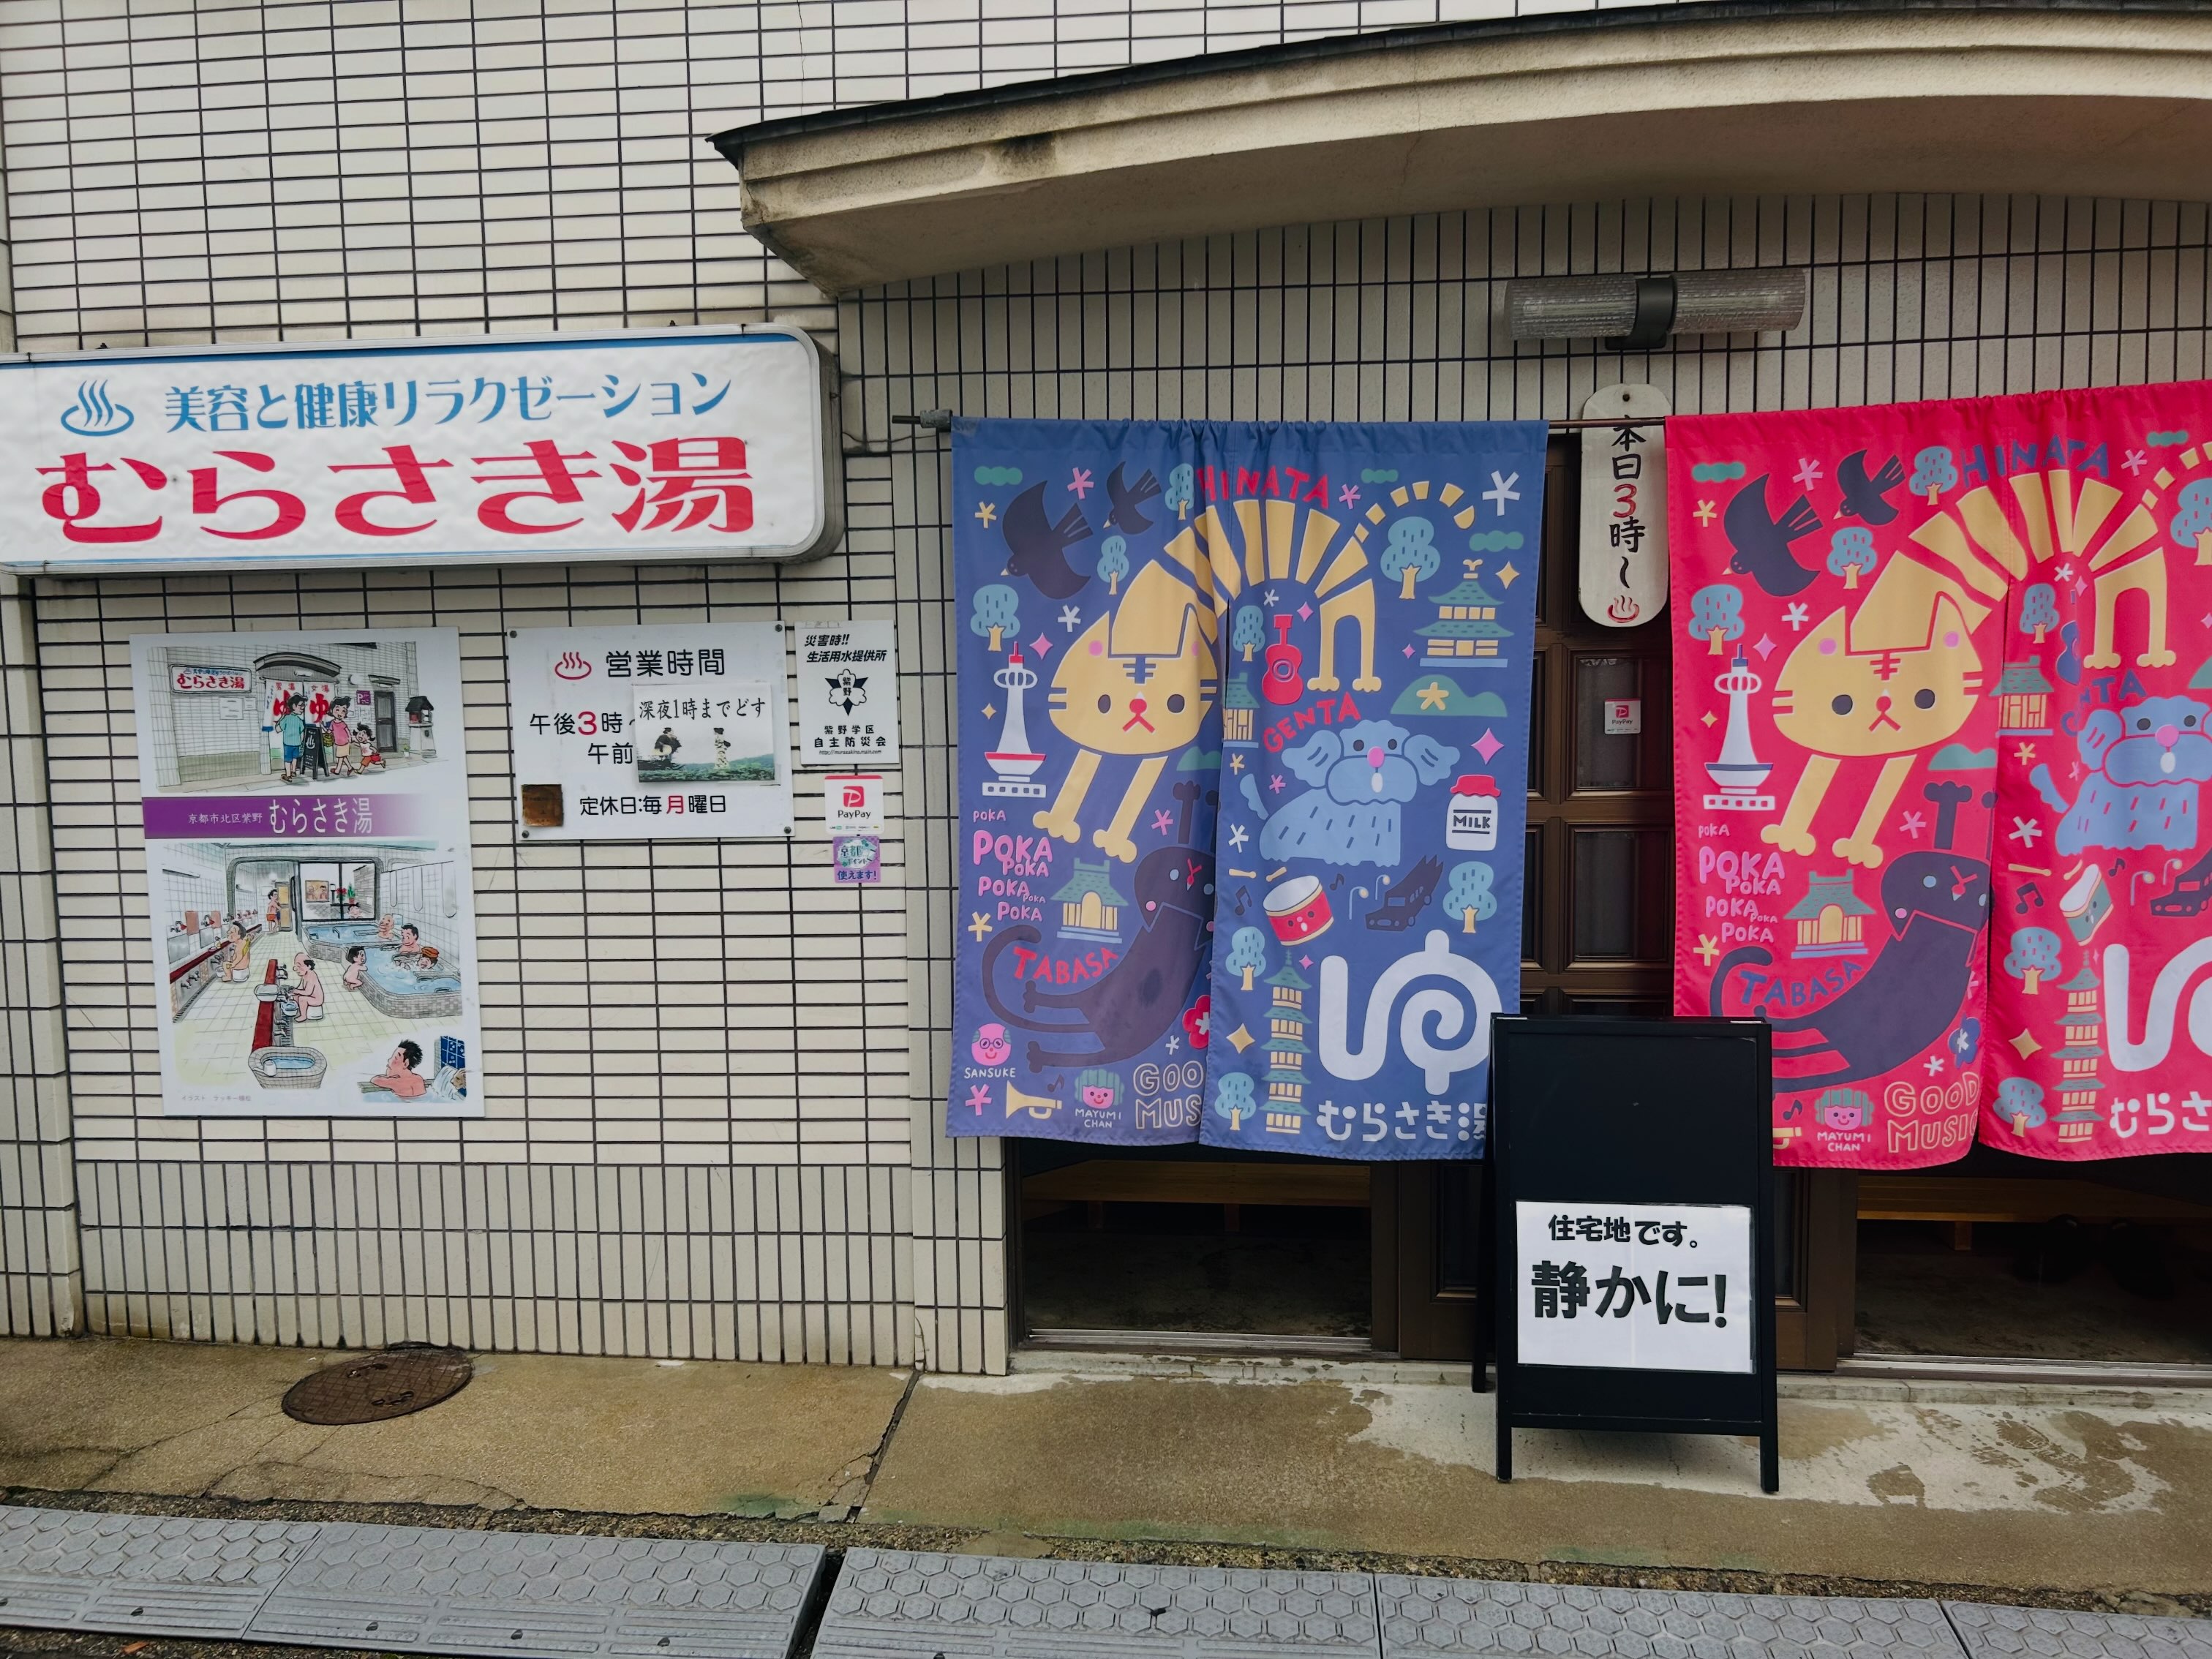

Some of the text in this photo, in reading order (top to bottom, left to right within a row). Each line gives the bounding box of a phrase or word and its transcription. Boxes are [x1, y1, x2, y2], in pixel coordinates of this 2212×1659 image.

[165, 371, 731, 433] 美容と健康リラクゼーション
[1960, 434, 2109, 489] HINATA
[35, 437, 754, 543] むらさき湯
[1196, 464, 1329, 509] HINATA
[606, 649, 725, 678] 営業時間
[806, 650, 887, 663] 生活用水提供所
[177, 673, 245, 689] むらさき湯
[639, 697, 766, 721] 深夜1時までどす
[824, 725, 875, 734] 紫野学区
[1263, 692, 1361, 753] GENTA
[587, 742, 633, 764] 午前
[814, 736, 887, 748] 自主防災会
[187, 797, 372, 834] 京都市北区紫野 むらさき湯
[838, 810, 871, 819] PayPay
[1453, 815, 1491, 830] MILK
[838, 870, 876, 880] 使えます!
[1012, 947, 1118, 985] TABASA
[1739, 960, 1862, 1007] TABASA
[964, 1067, 1016, 1078] SANSUKE
[1884, 1072, 1980, 1118] GOOD
[1075, 1108, 1121, 1120] MAYUMI
[1084, 1118, 1113, 1129] CHAN
[1817, 1132, 1871, 1143] MAYUMI
[1828, 1142, 1861, 1152] CHAN
[1548, 1214, 1698, 1248] 住宅地です。
[1531, 1260, 1727, 1328] 静かに!
